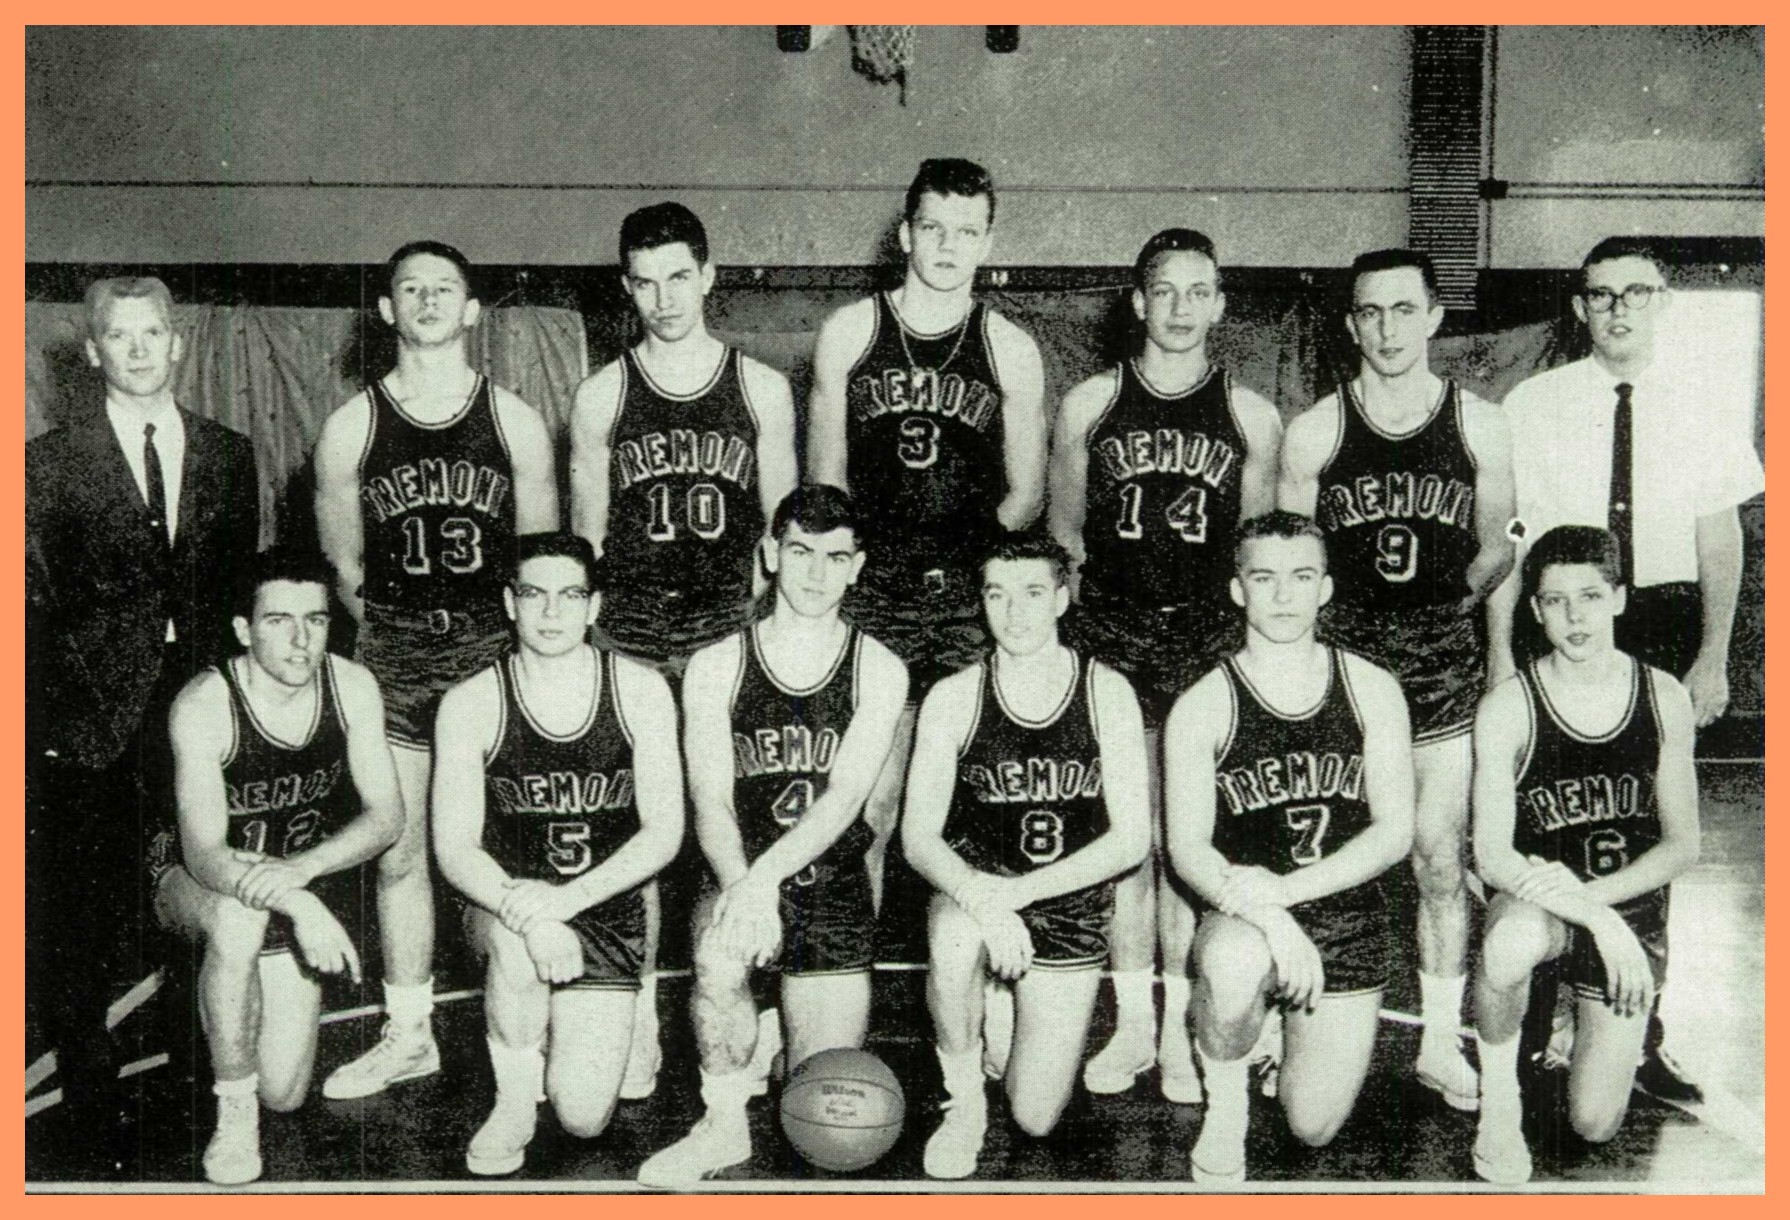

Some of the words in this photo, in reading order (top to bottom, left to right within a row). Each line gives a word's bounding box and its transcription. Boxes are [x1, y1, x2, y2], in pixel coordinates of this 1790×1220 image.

[898, 416, 940, 469] 3
[647, 483, 725, 541] 10
[1116, 483, 1207, 543] 14
[401, 516, 483, 575] 13
[1375, 524, 1418, 582] 9
[770, 780, 814, 825] 4
[547, 822, 592, 875] 5
[1020, 810, 1065, 864] 8
[1285, 803, 1330, 861] 7
[1584, 828, 1630, 879] 6
